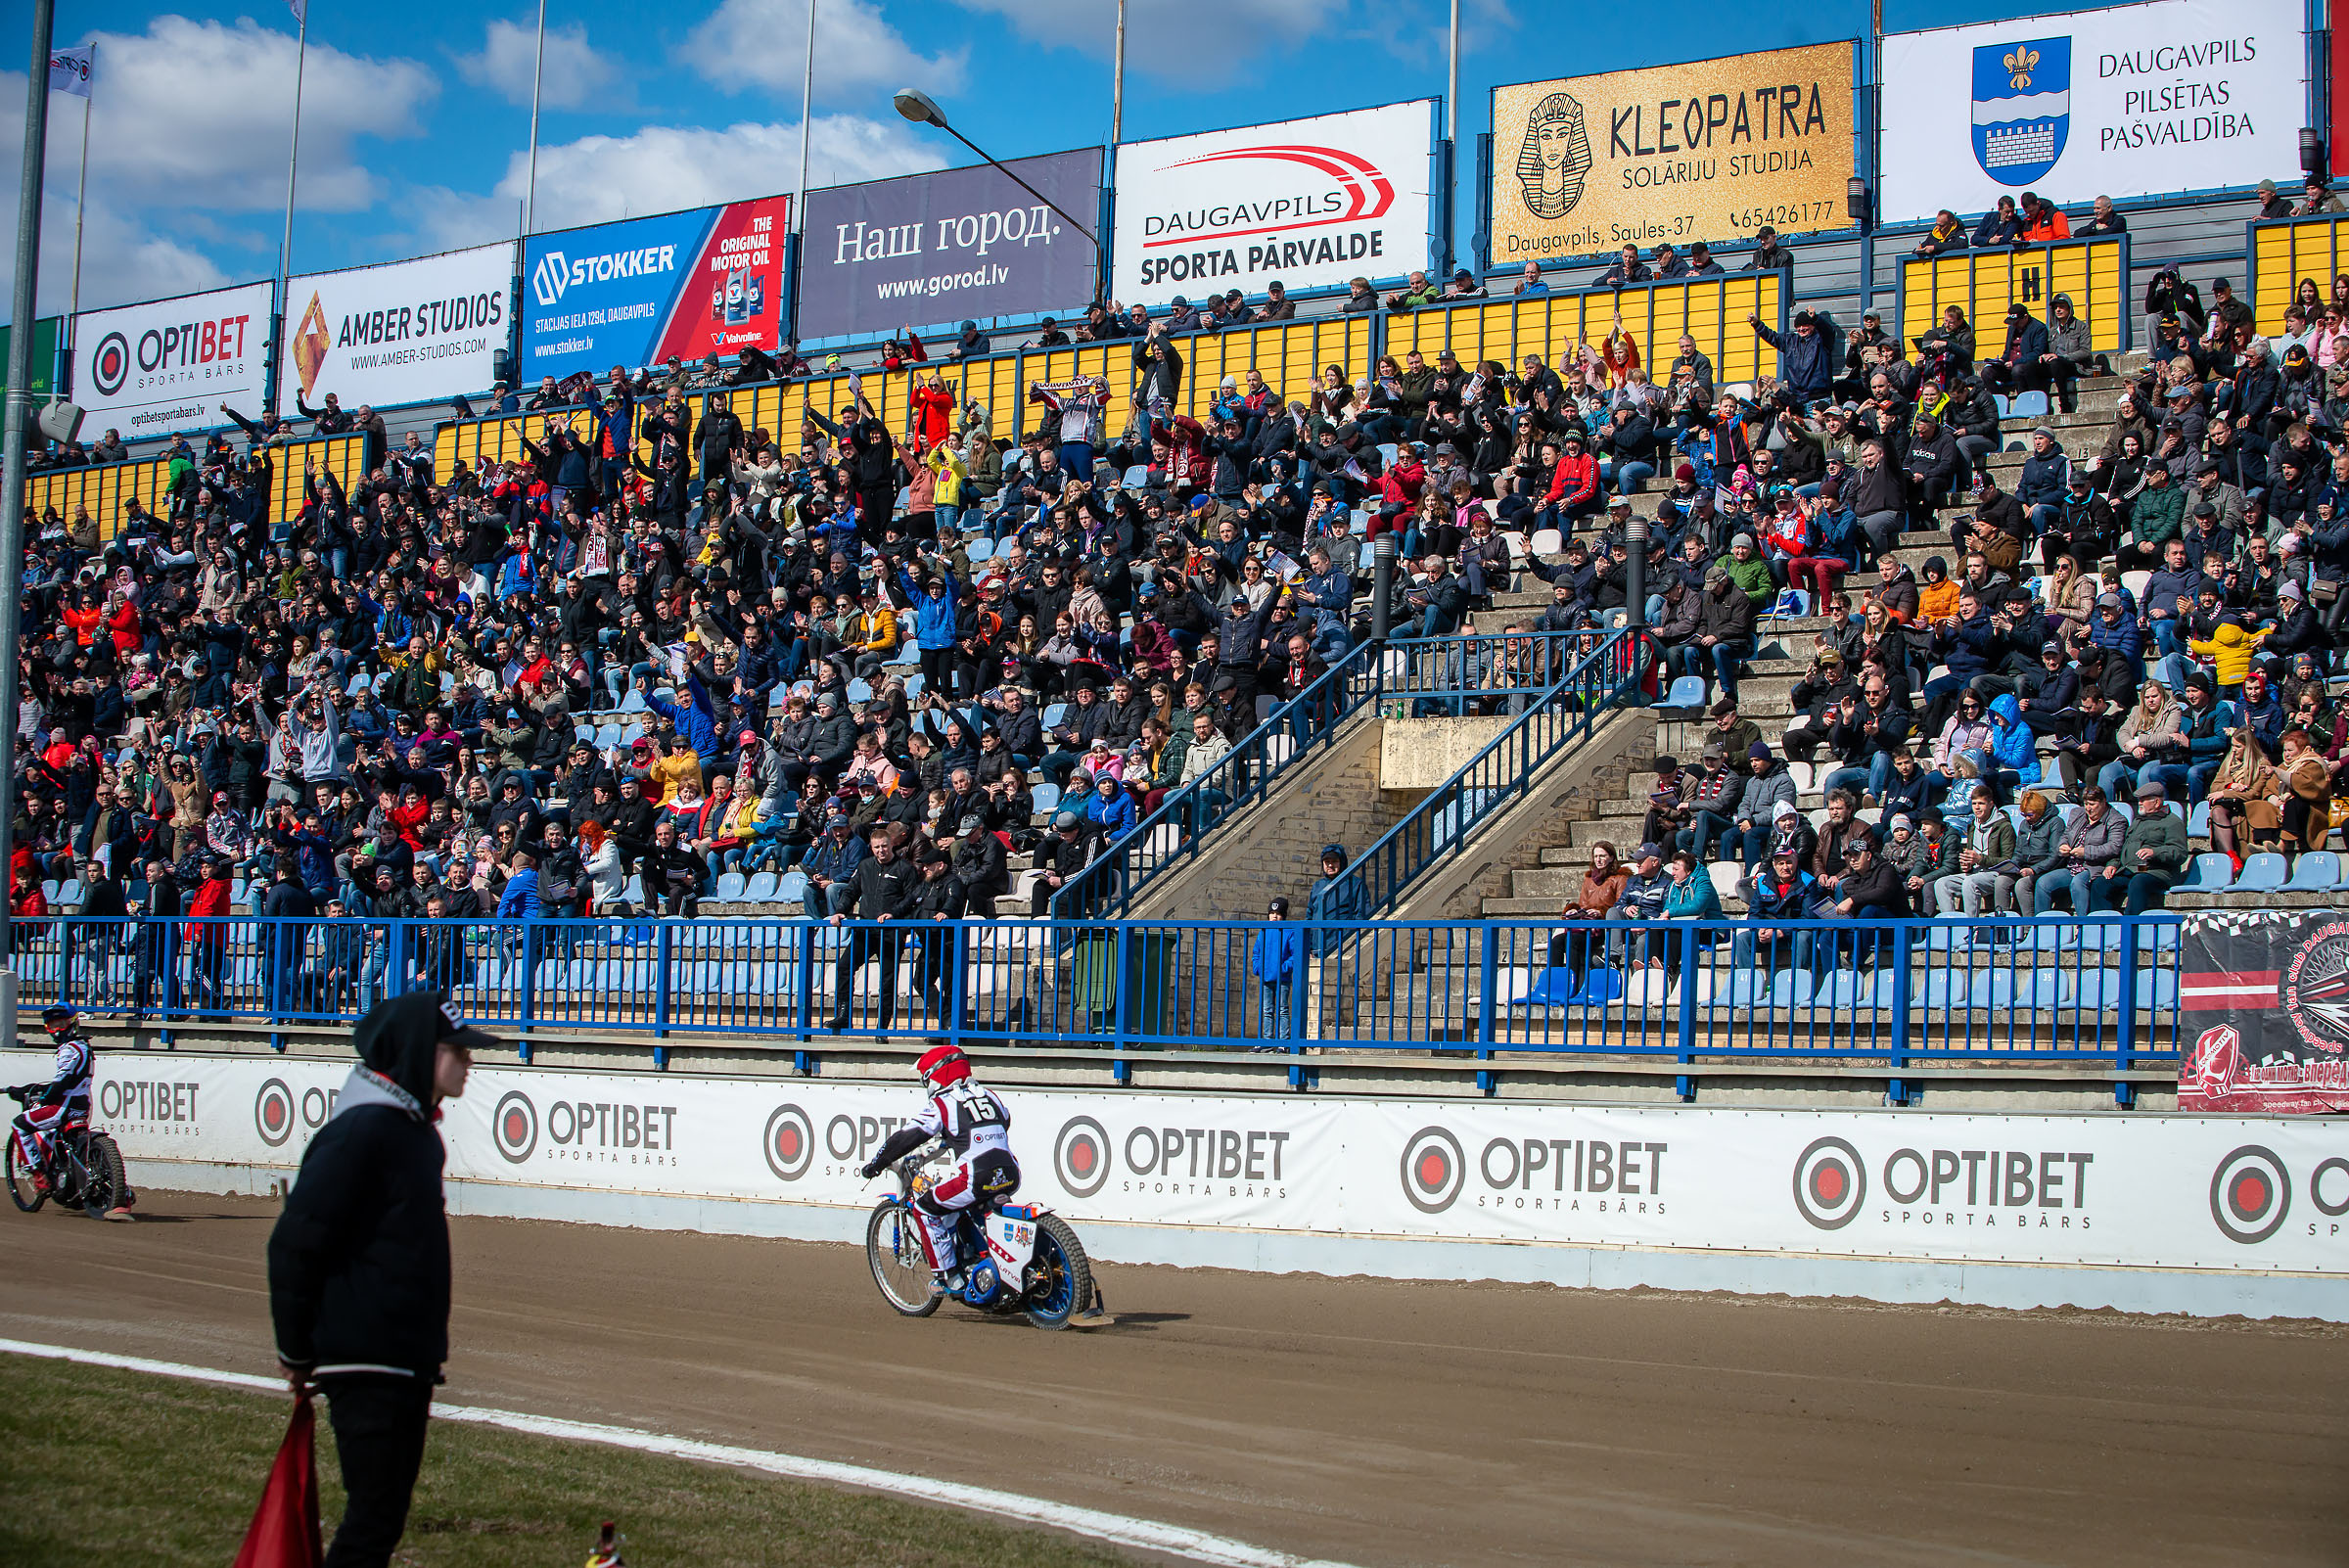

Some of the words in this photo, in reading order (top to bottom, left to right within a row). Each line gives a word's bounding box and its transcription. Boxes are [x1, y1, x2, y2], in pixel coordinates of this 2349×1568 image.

[2099, 37, 2256, 78] DAUGAVPILS
[2125, 79, 2231, 115] PILSĒTAS
[1610, 82, 1826, 158] KLEOPATRA
[2100, 111, 2255, 152] PAŠVALDĪBA
[1622, 157, 1717, 190] SOLĀRIJU
[1728, 148, 1815, 177] STUDIJA
[753, 215, 773, 233] THE
[1144, 191, 1343, 236] DAUGAVPILS
[1507, 226, 1606, 260] Daugavpils,
[1610, 215, 1695, 245] Saules-37
[1741, 201, 1835, 229] 65426177
[720, 233, 771, 254] ORIGINAL
[833, 221, 924, 265] Наш
[937, 202, 1062, 256] город.
[570, 245, 674, 286] STOKKER
[711, 253, 751, 272] MOTOR
[752, 250, 770, 266] OIL
[1140, 248, 1239, 286] SPORTA
[1248, 230, 1383, 273] PĀRVALDE
[877, 263, 1009, 300] www.gorod.lv
[2021, 266, 2041, 302] H
[338, 305, 411, 349] AMBER
[415, 290, 502, 339] STUDIOS
[535, 315, 569, 334] STACIJAS
[570, 312, 587, 329] IELA
[607, 301, 655, 323] DAUGAVPILS
[138, 314, 250, 373] OPTIBET
[350, 337, 486, 370] WWW.AMBER-STUDIOS.COM
[534, 336, 594, 357] www.stokker.lv
[726, 332, 762, 345] Valvoline
[138, 371, 196, 390] SPORTA
[205, 363, 245, 382] BĀRS
[131, 402, 207, 428] optibetsportabars.lv
[2287, 951, 2307, 984] club
[2286, 986, 2299, 1011] fan
[100, 1080, 200, 1122] OPTIBET
[962, 1097, 996, 1123] 15
[101, 1123, 155, 1135] SPORTA
[164, 1124, 200, 1136] BĀRS
[547, 1100, 677, 1151] OPTIBET
[547, 1148, 619, 1163] SPORTA
[631, 1150, 677, 1167] BĀRS
[1125, 1126, 1290, 1180] OPTIBET
[1480, 1136, 1668, 1195] OPTIBET
[1123, 1180, 1212, 1196] SPORTA
[1229, 1183, 1286, 1199] BĀRS
[1883, 1147, 2094, 1209] OPTIBET
[1478, 1195, 1580, 1212] SPORTA
[1599, 1197, 1666, 1215] BĀRS
[1883, 1210, 1996, 1226] SPORTA
[2018, 1212, 2091, 1229] BĀRS
[998, 1264, 1021, 1284] LATVIA
